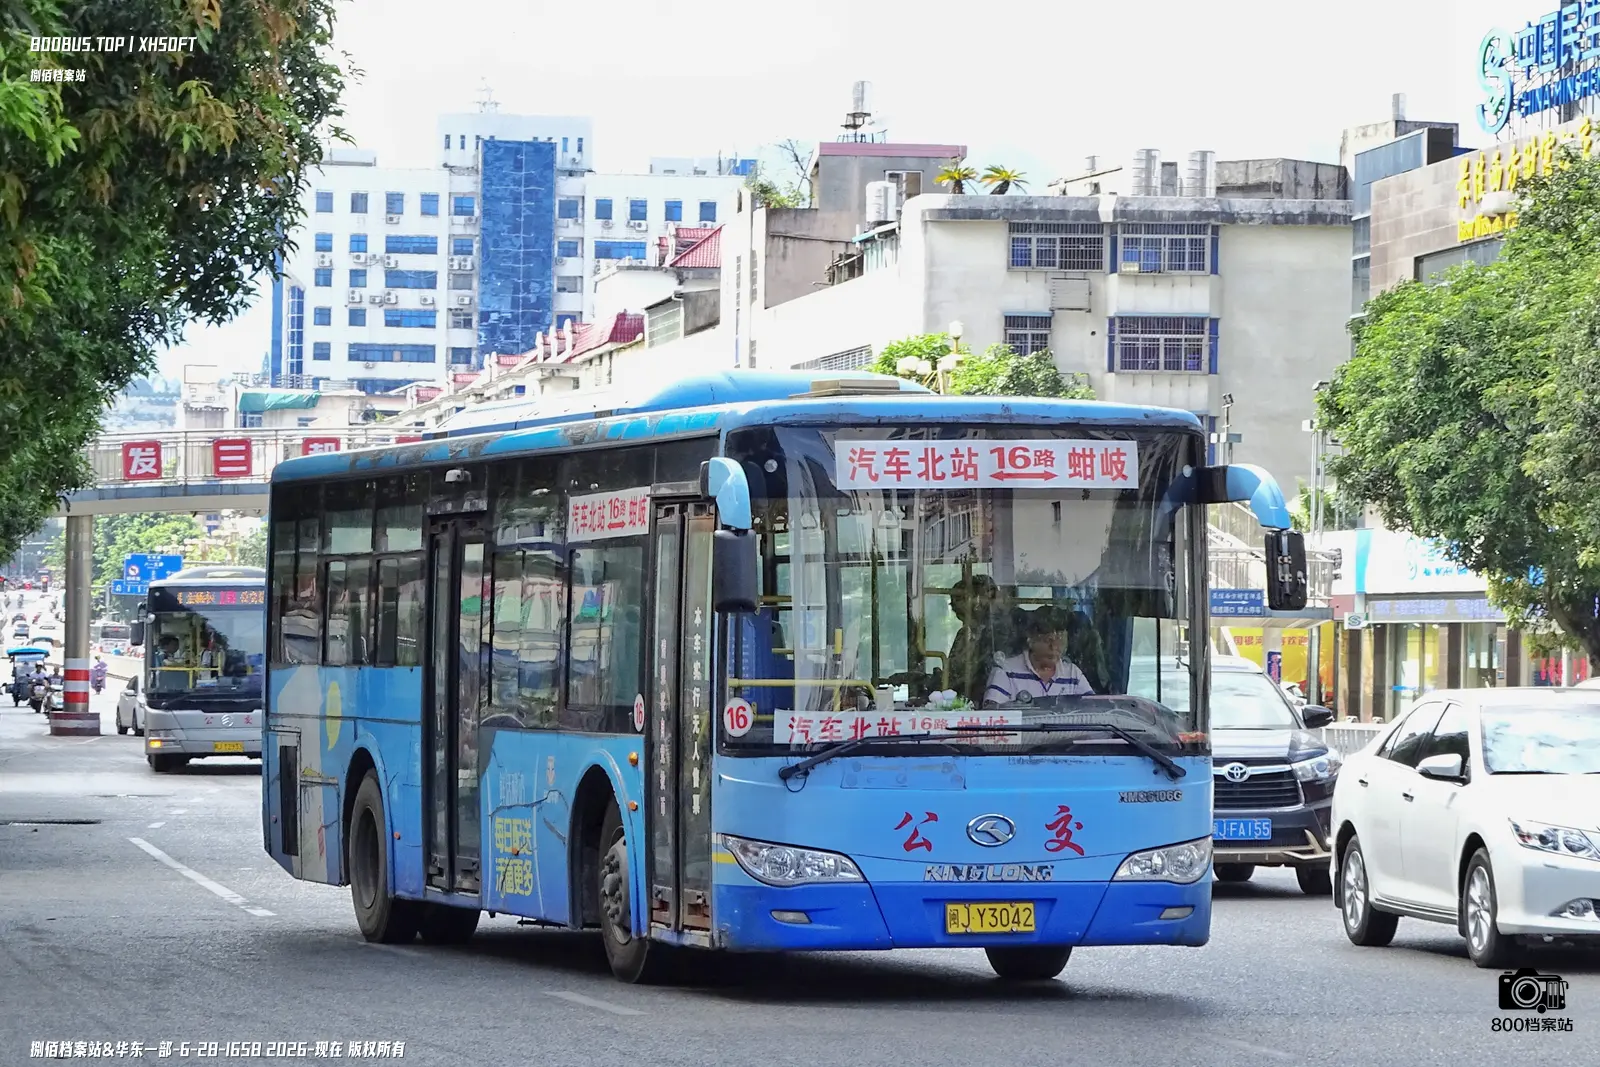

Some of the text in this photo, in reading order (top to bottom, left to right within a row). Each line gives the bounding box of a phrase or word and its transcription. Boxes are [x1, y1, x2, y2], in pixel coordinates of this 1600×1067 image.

[847, 446, 1129, 482] 汽车北站 16路 蚶岐
[572, 499, 606, 535] 汽车北站
[635, 702, 643, 724] 16
[692, 606, 702, 816] 本车实行无人售票
[727, 705, 748, 730] 16
[788, 715, 903, 744] 汽车北站
[909, 717, 949, 731] 16路
[894, 804, 1085, 856] 公 交
